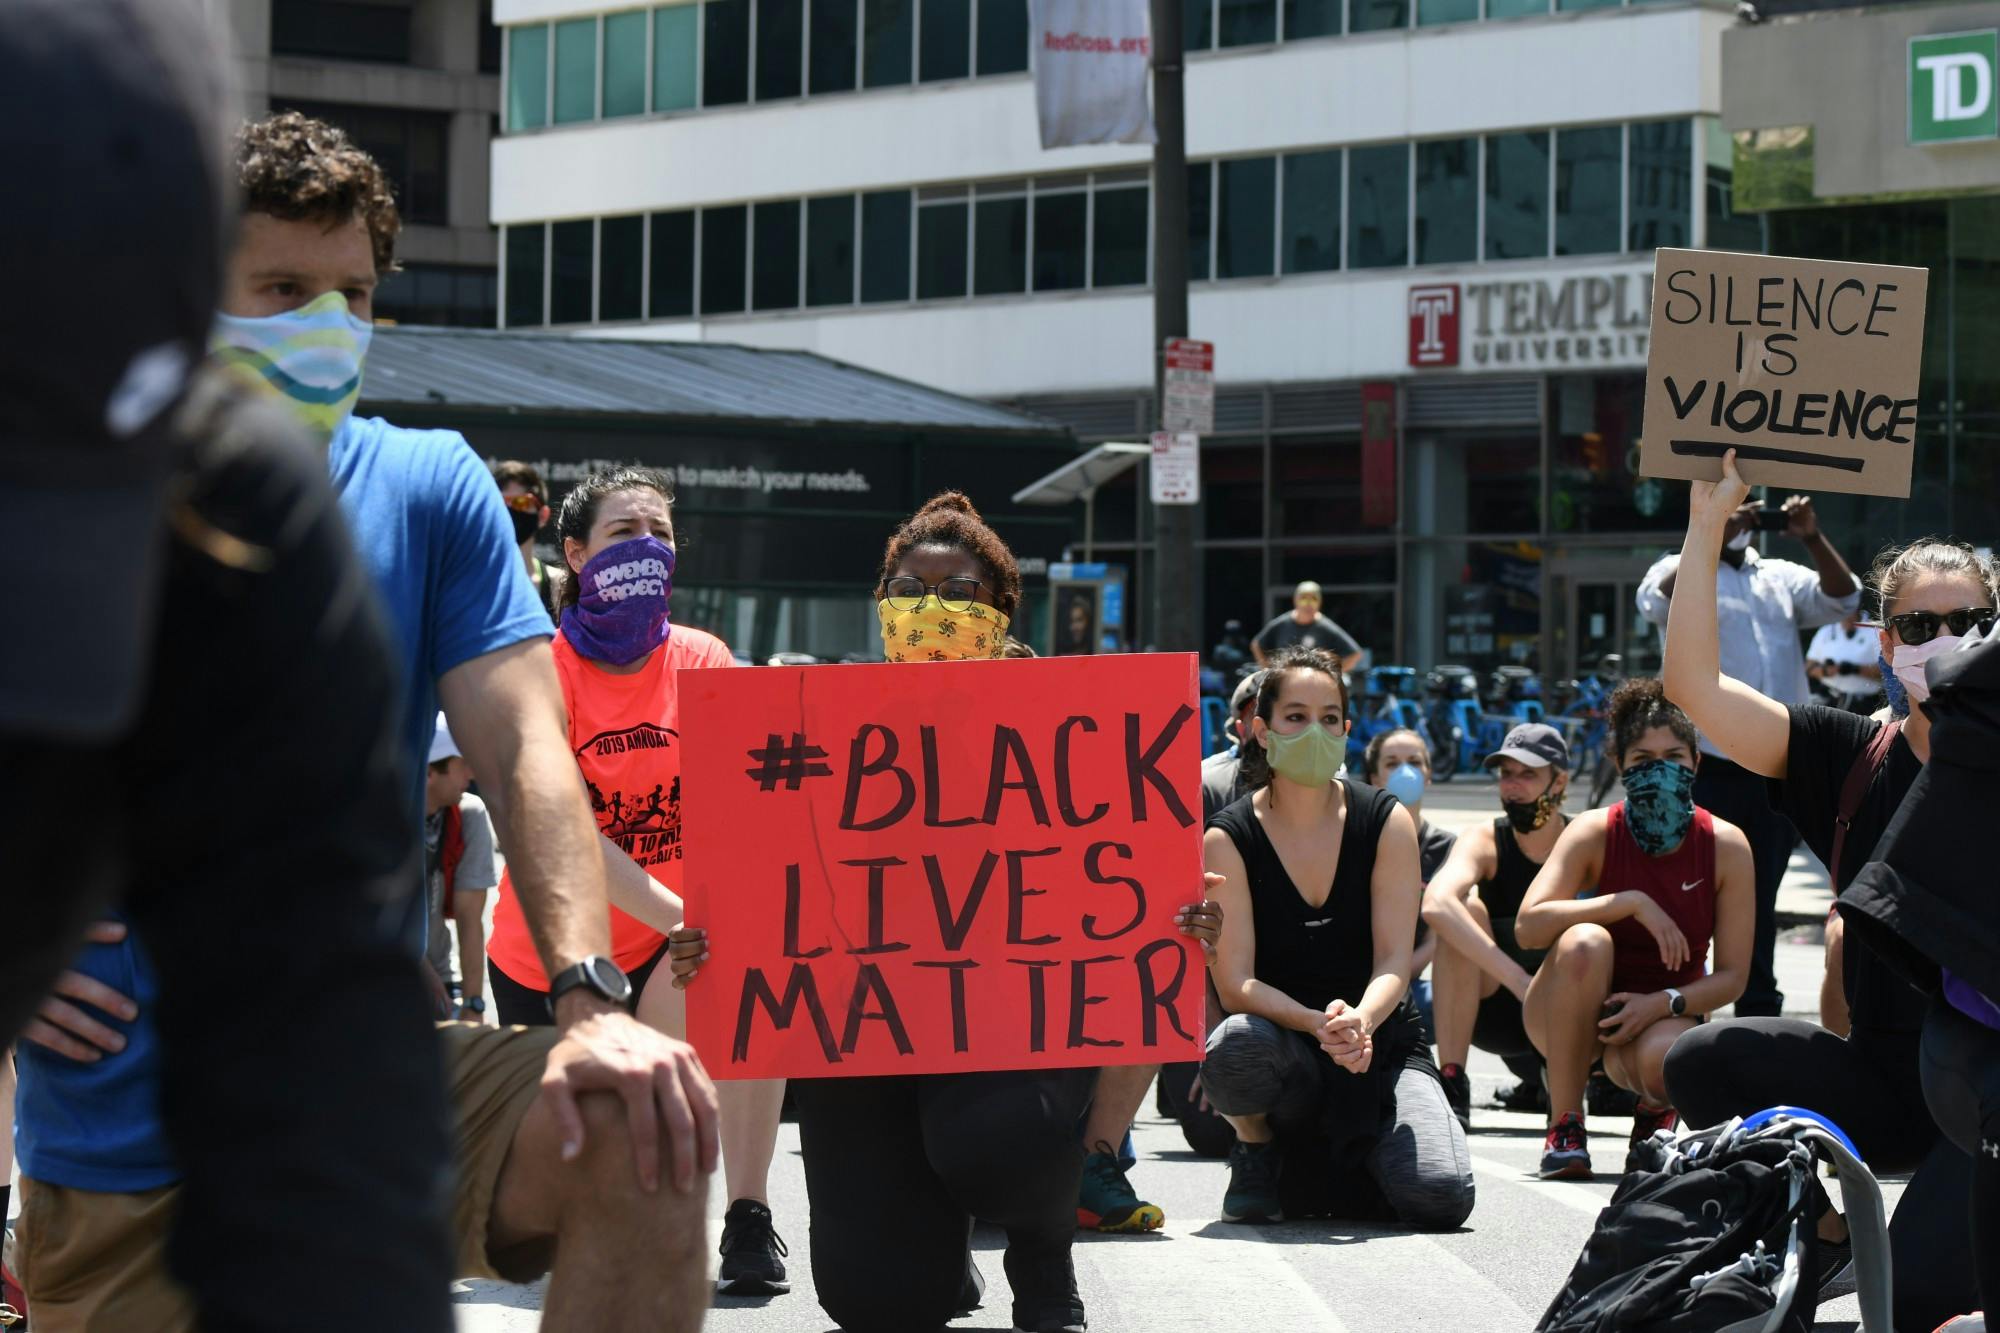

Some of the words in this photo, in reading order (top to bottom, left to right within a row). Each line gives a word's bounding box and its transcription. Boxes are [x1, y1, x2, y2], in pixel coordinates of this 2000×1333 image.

[1917, 52, 1992, 121] TD
[1411, 288, 1454, 361] T
[1665, 270, 1898, 337] SILENCE
[1473, 334, 1648, 364] UNIVERSIT
[1735, 331, 1798, 376] IS
[1663, 375, 1918, 444] VIOLENCE
[677, 464, 698, 486] to
[700, 466, 761, 488] match
[762, 472, 804, 493] your
[806, 469, 870, 491] needs.
[594, 558, 668, 590] NOVEMBER
[598, 578, 665, 602] PROJECT
[596, 735, 625, 756] 2019
[625, 727, 669, 751] ANNUAL
[745, 703, 1197, 832] #BLACK
[783, 841, 1147, 958] LIVES
[731, 938, 1198, 1064] MATTER
